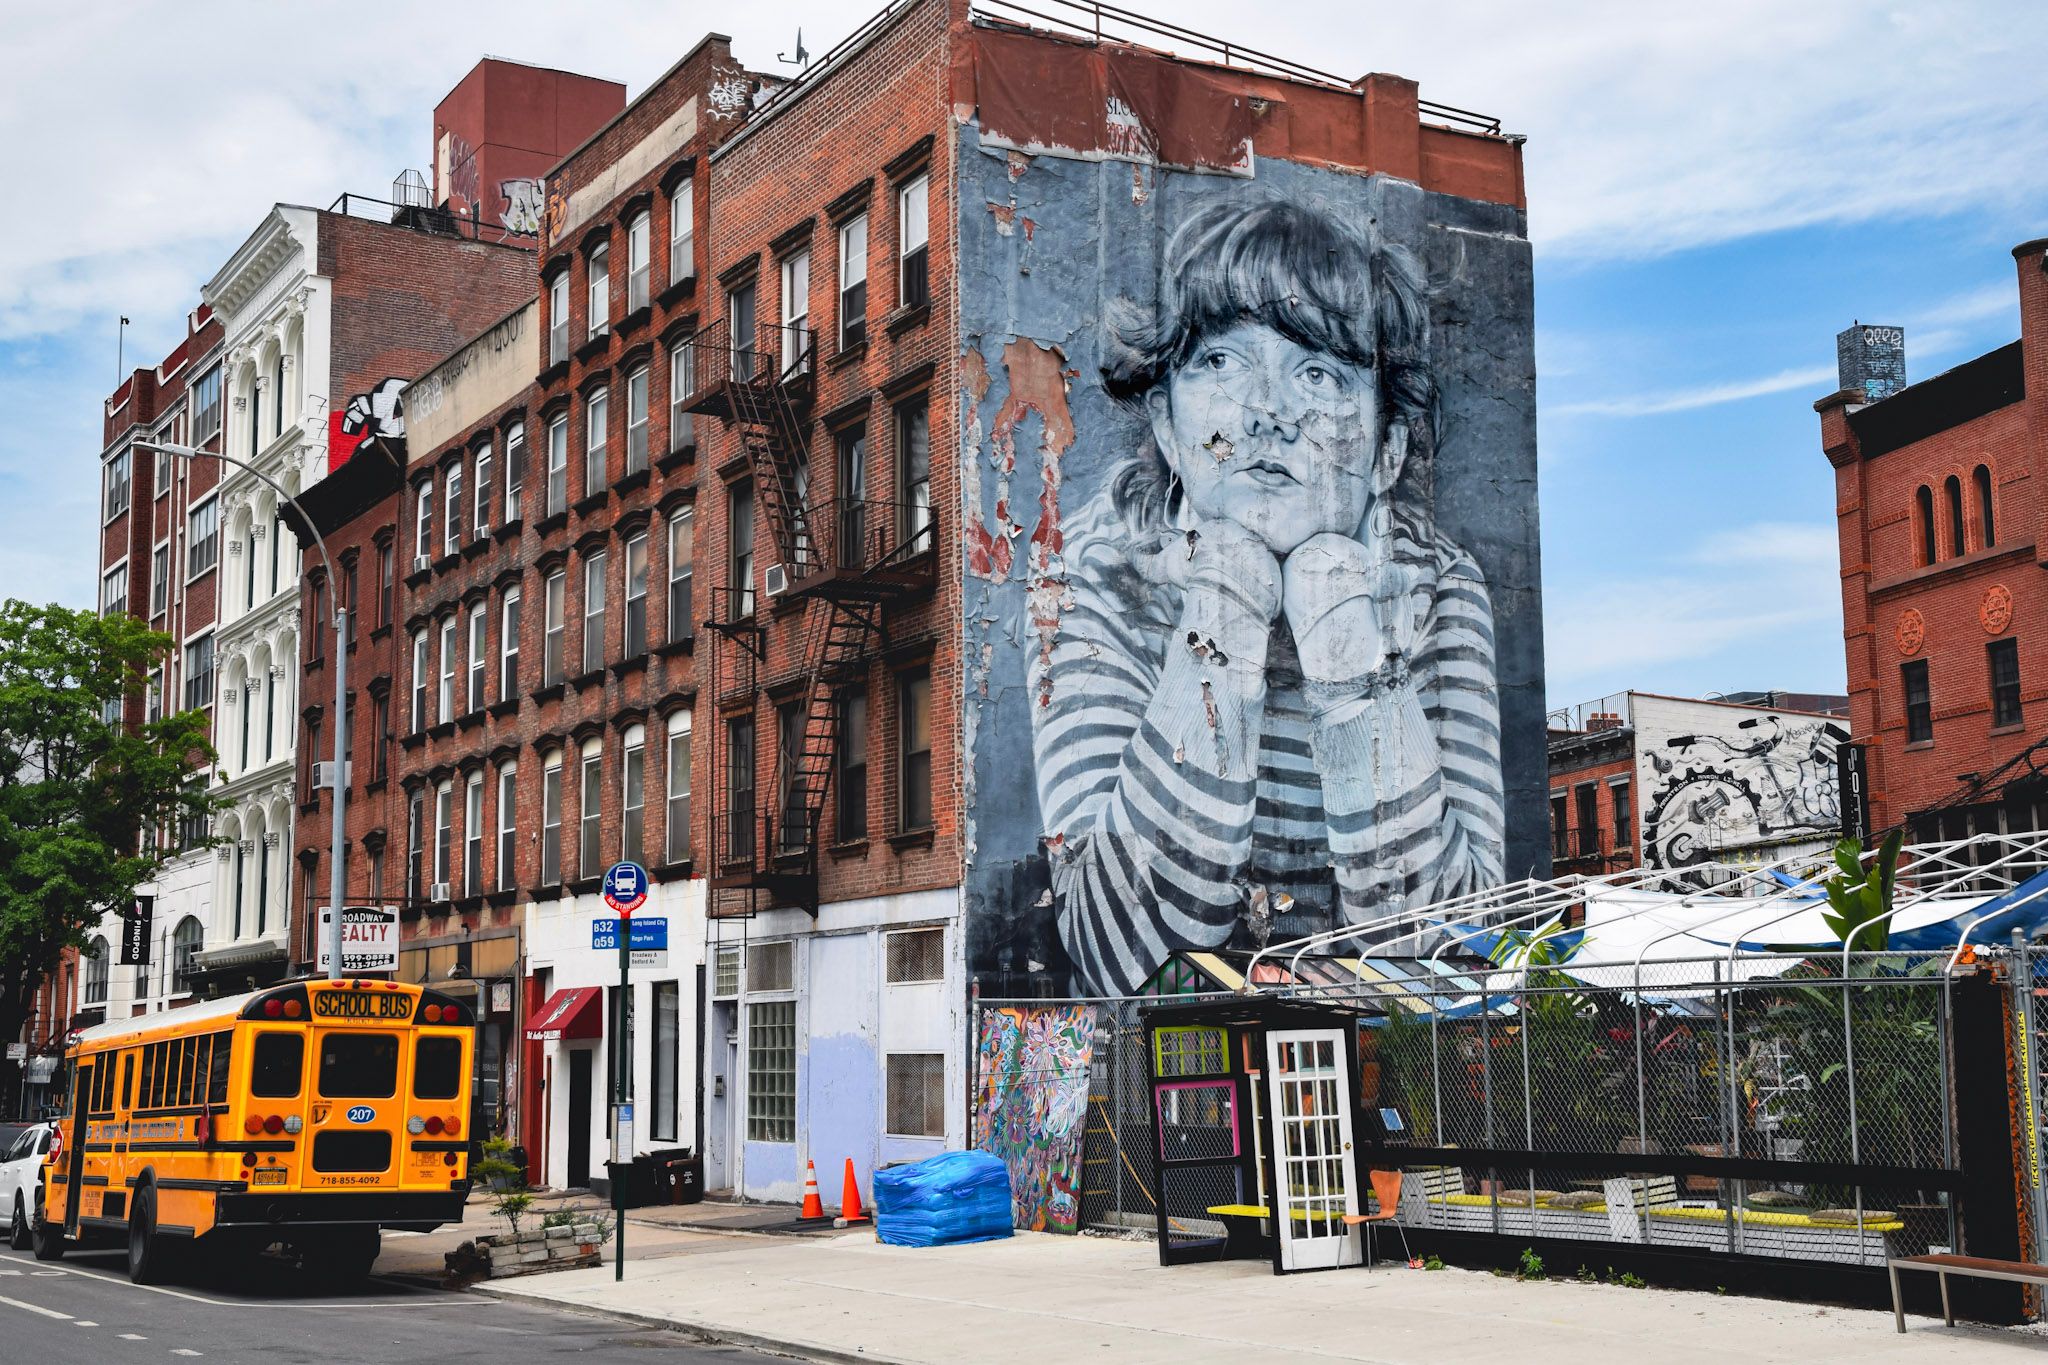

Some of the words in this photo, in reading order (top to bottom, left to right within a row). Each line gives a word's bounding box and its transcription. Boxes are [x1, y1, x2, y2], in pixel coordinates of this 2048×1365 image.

[607, 897, 615, 906] NO
[615, 896, 643, 910] STANDING
[342, 913, 384, 922] ROADWAY
[594, 921, 613, 932] B32
[330, 924, 388, 942] EALTY
[131, 919, 142, 961] PINGPOD
[594, 936, 614, 947] Q59
[319, 993, 375, 1016] SCHOOL
[380, 994, 407, 1017] BUS
[351, 1109, 371, 1120] 207
